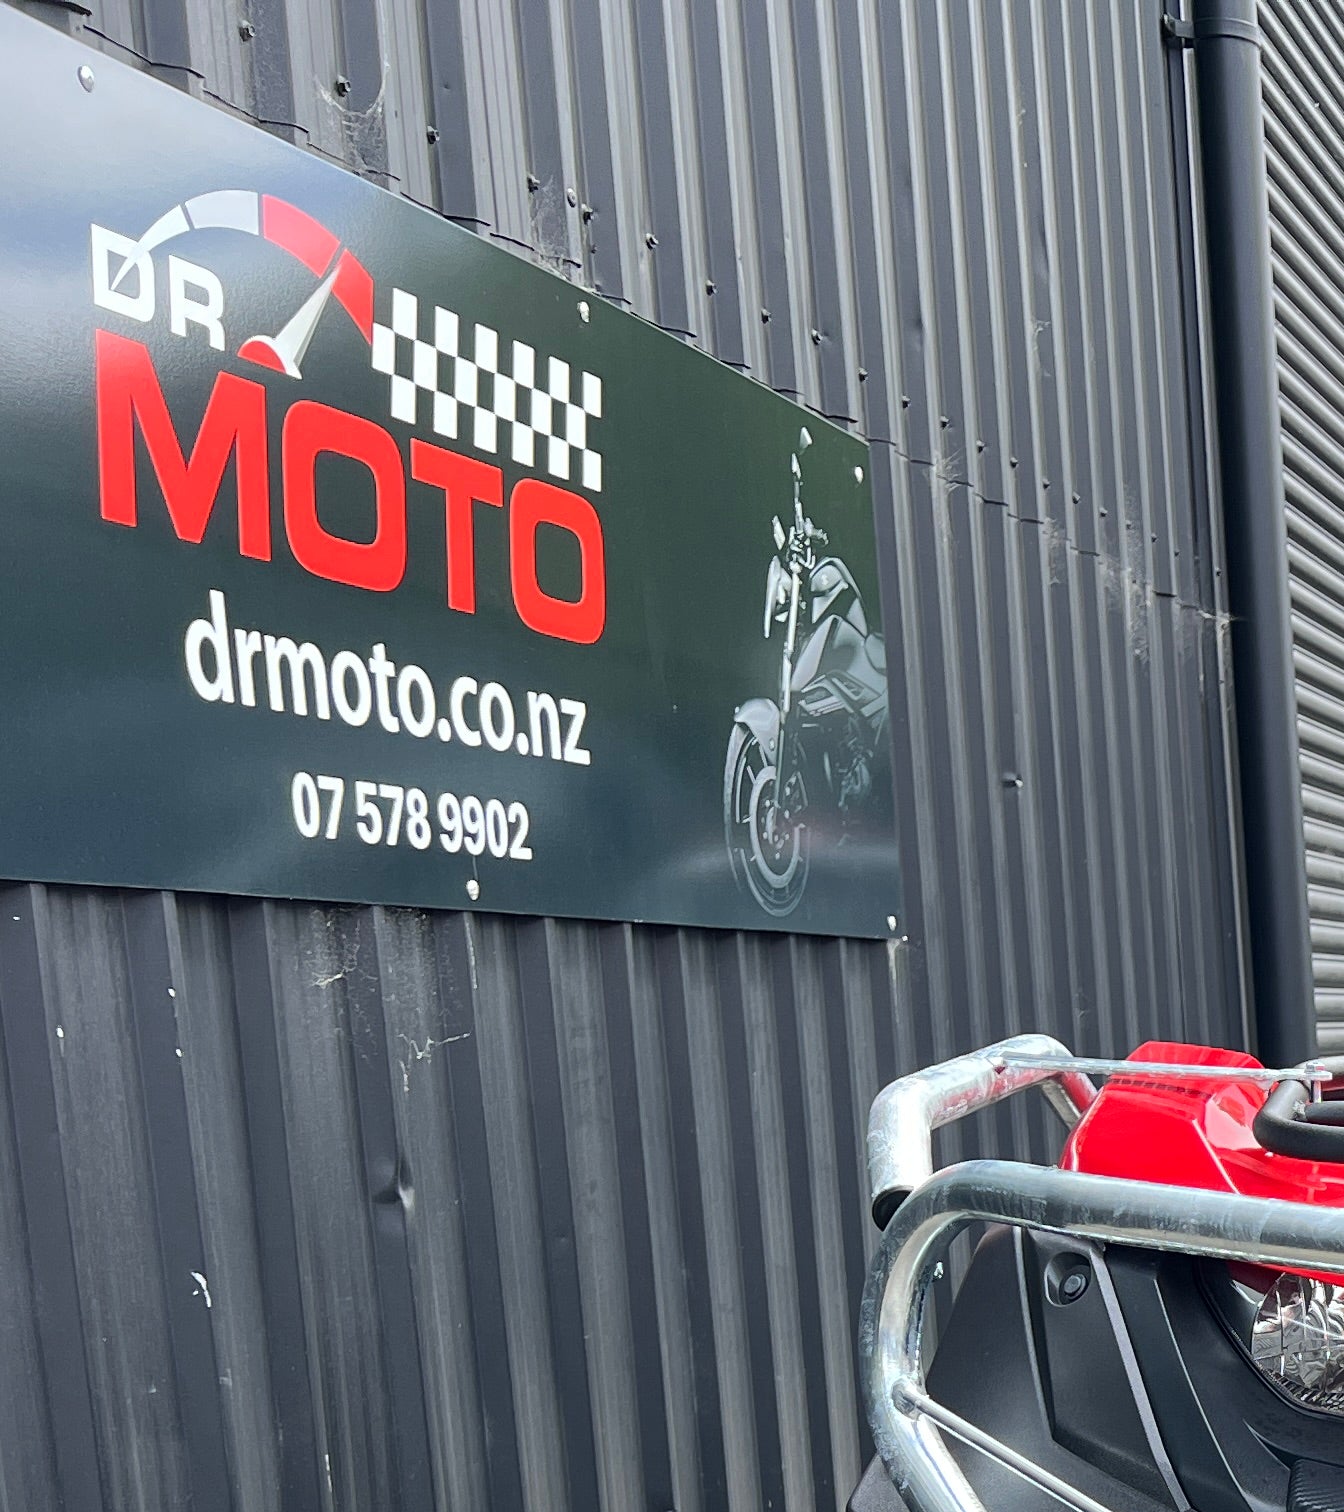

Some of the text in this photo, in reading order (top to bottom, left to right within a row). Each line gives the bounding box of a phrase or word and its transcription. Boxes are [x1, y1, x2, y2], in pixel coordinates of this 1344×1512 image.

[91, 222, 226, 352] DR
[95, 327, 607, 646] MOTO
[184, 588, 592, 767] drmoto.co.nz
[291, 770, 535, 862] 07 578 9902
